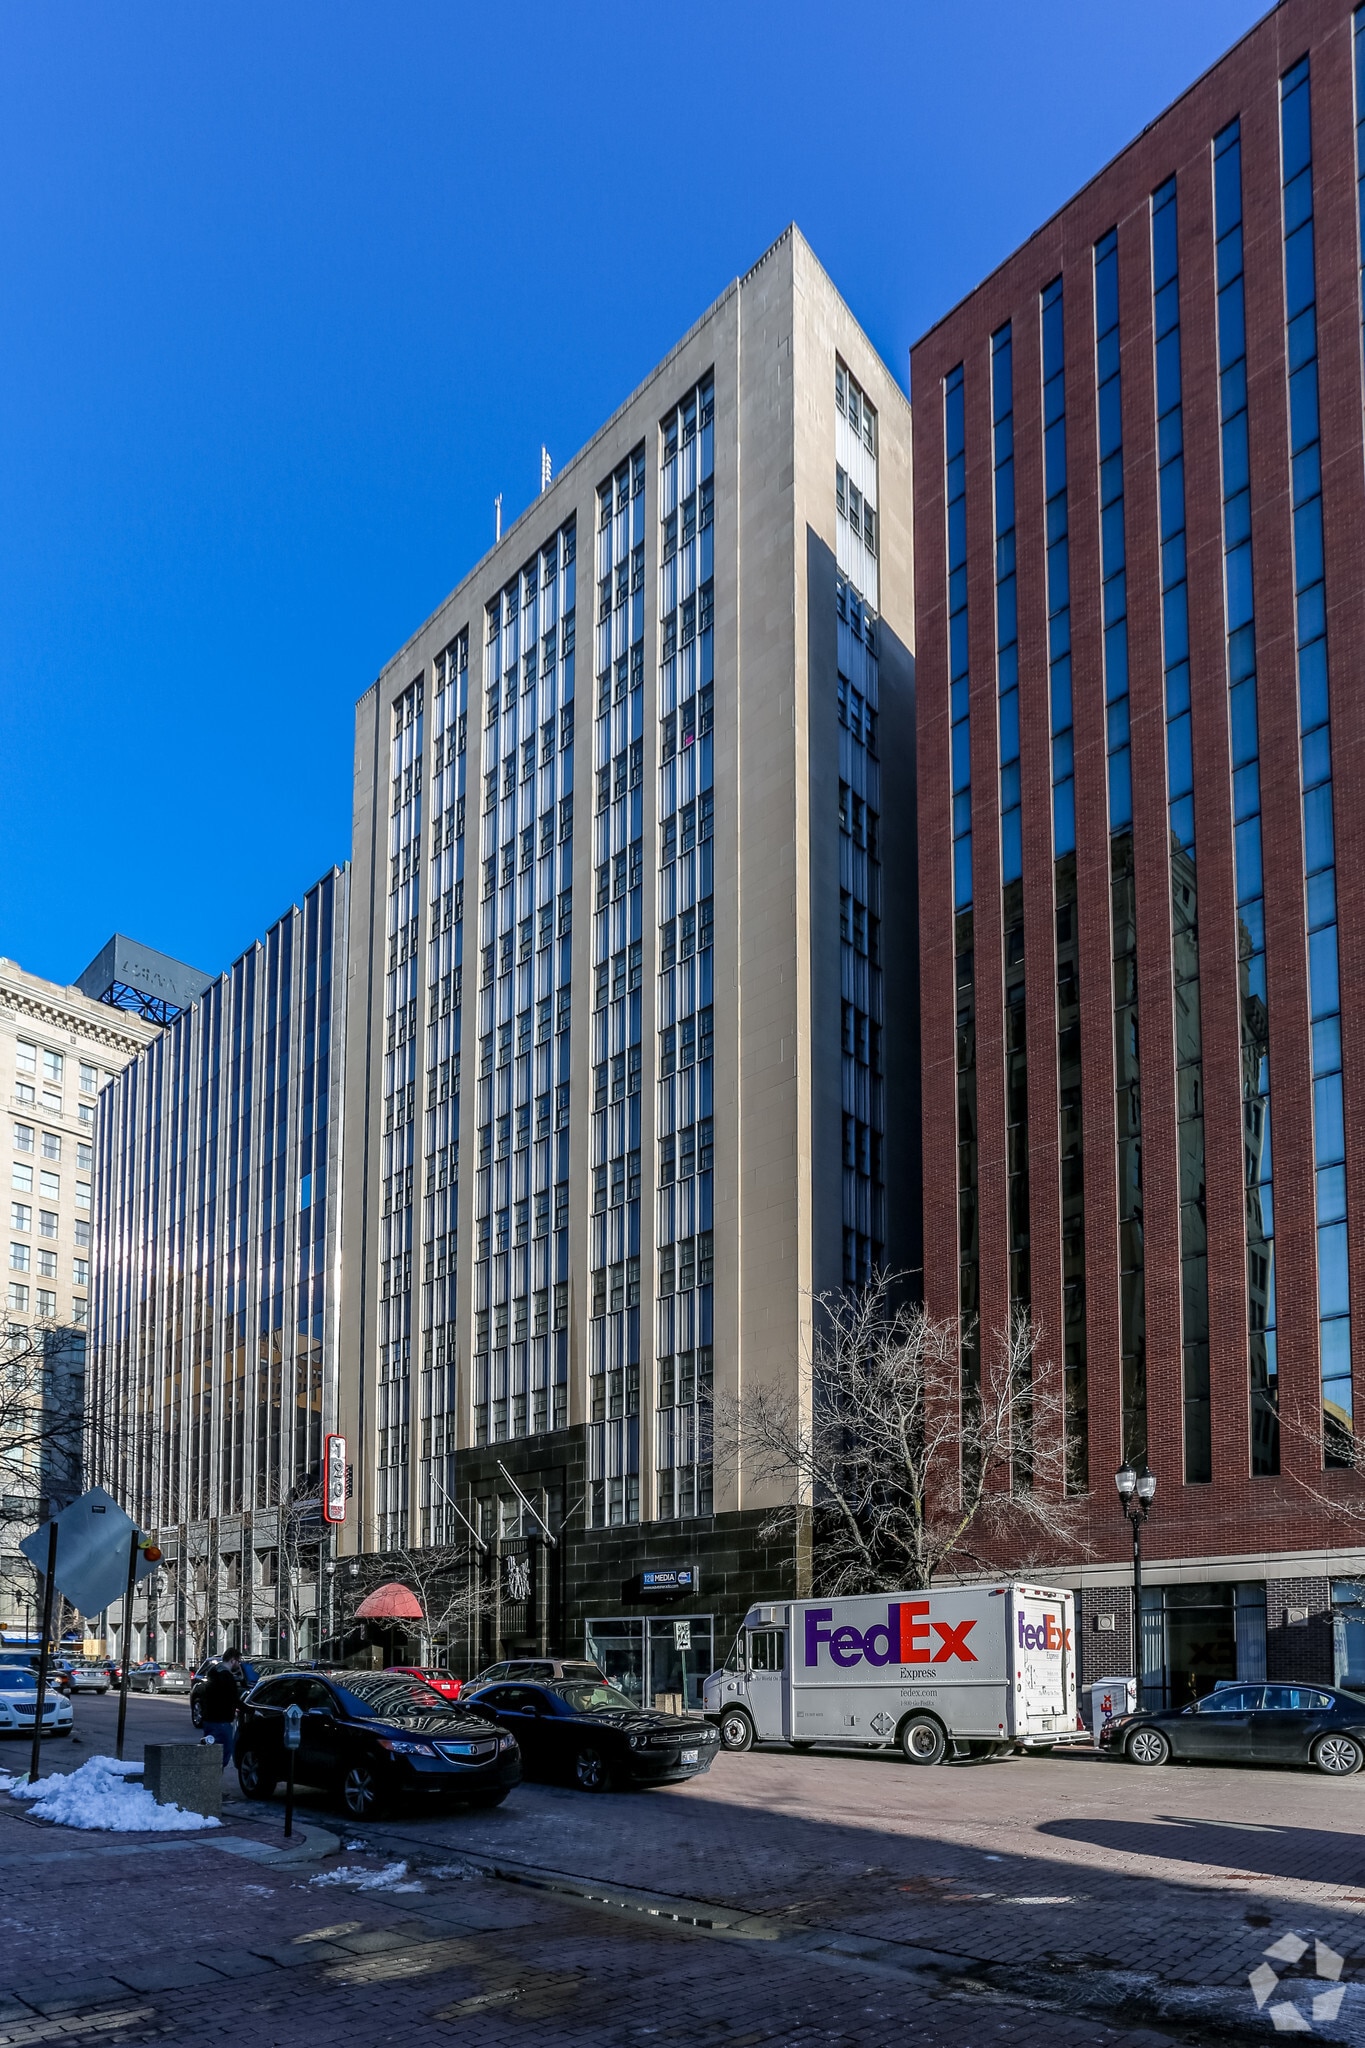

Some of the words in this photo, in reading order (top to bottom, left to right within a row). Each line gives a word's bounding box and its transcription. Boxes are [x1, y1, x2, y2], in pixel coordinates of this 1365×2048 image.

[654, 1573, 675, 1582] MEDIA
[804, 1601, 979, 1667] FedEx
[1018, 1611, 1072, 1651] FedEx
[900, 1667, 937, 1680] Express
[900, 1688, 938, 1697] fedex.com
